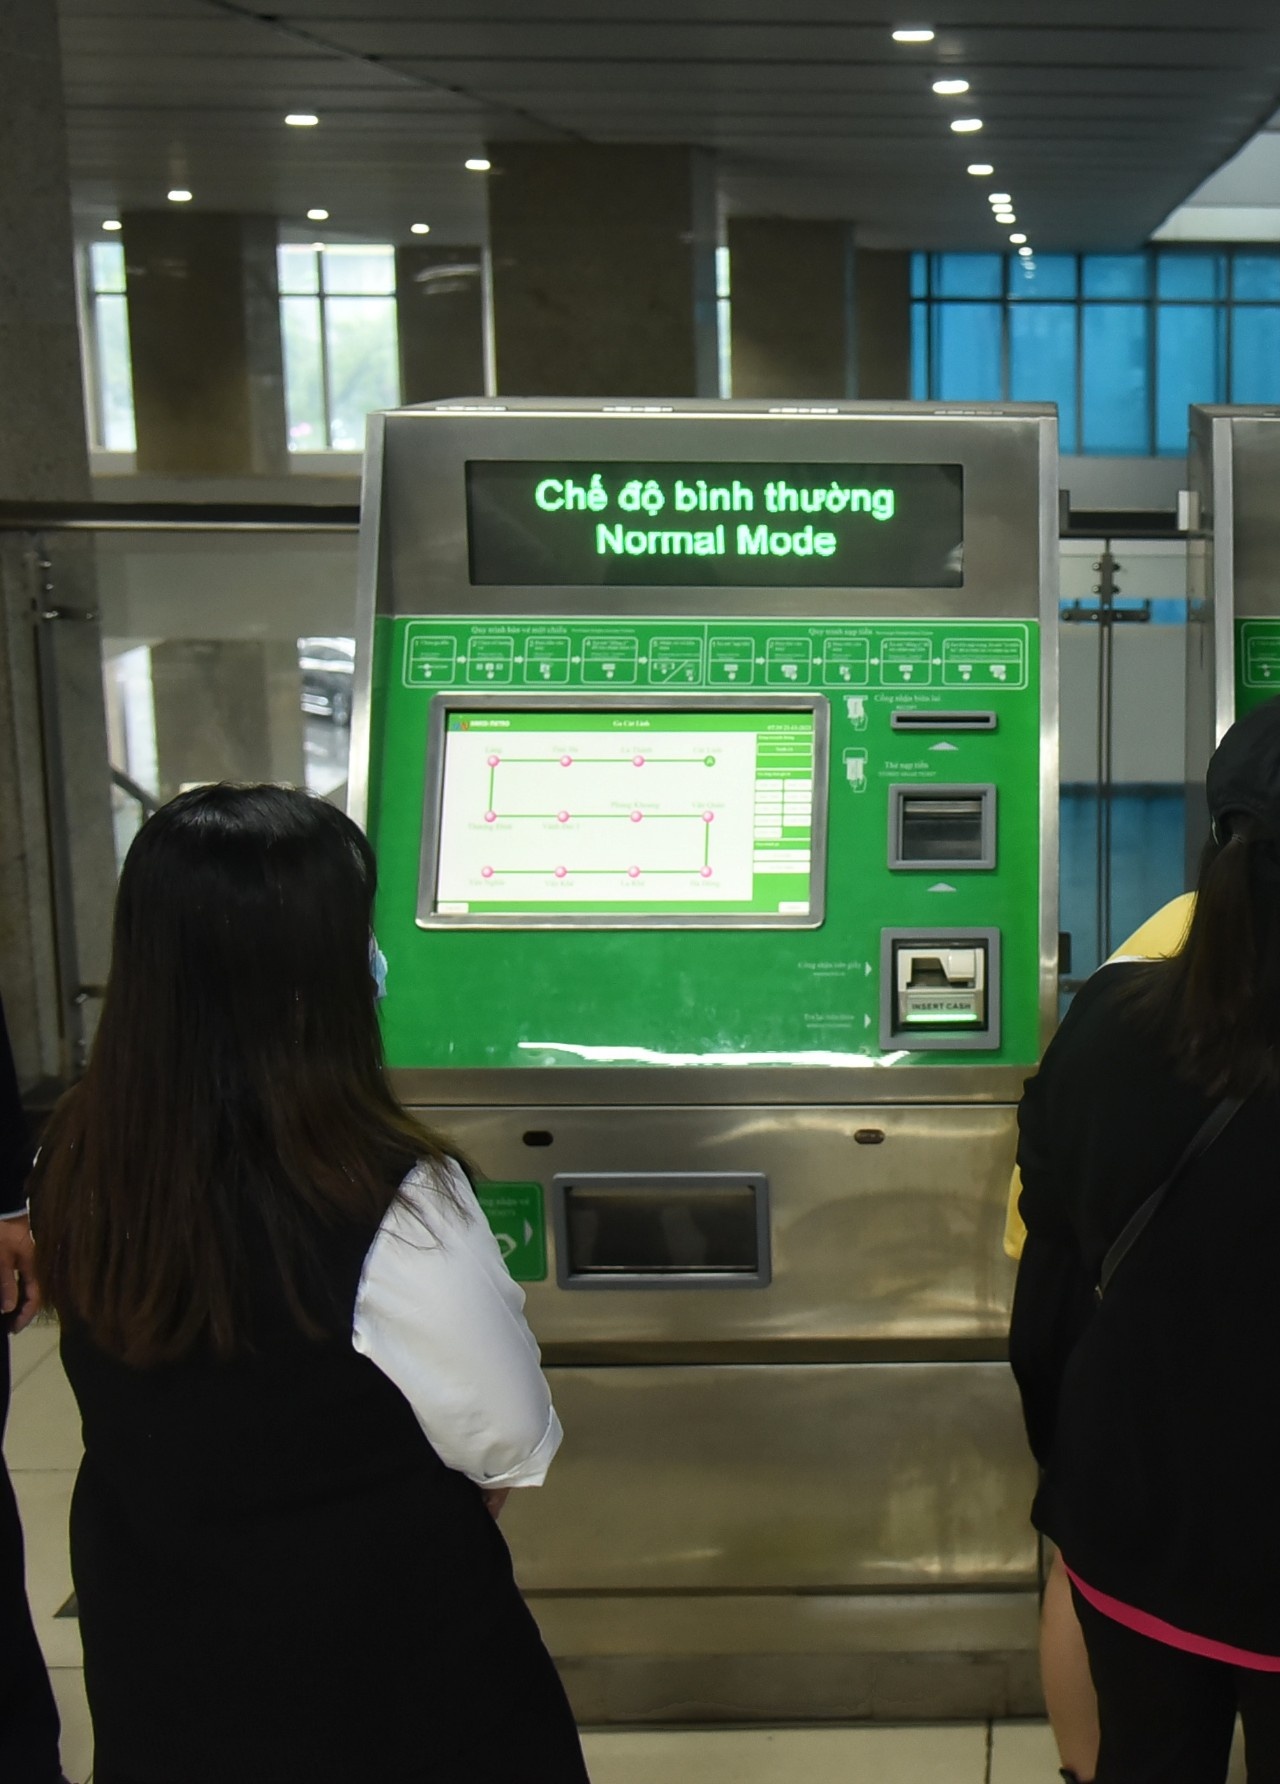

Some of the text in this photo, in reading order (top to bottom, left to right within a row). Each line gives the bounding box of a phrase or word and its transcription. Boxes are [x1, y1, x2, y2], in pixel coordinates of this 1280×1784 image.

[535, 474, 895, 521] Chế độ bình thường
[595, 523, 837, 556] Normal Mode
[911, 1002, 971, 1010] INSERT CASH
